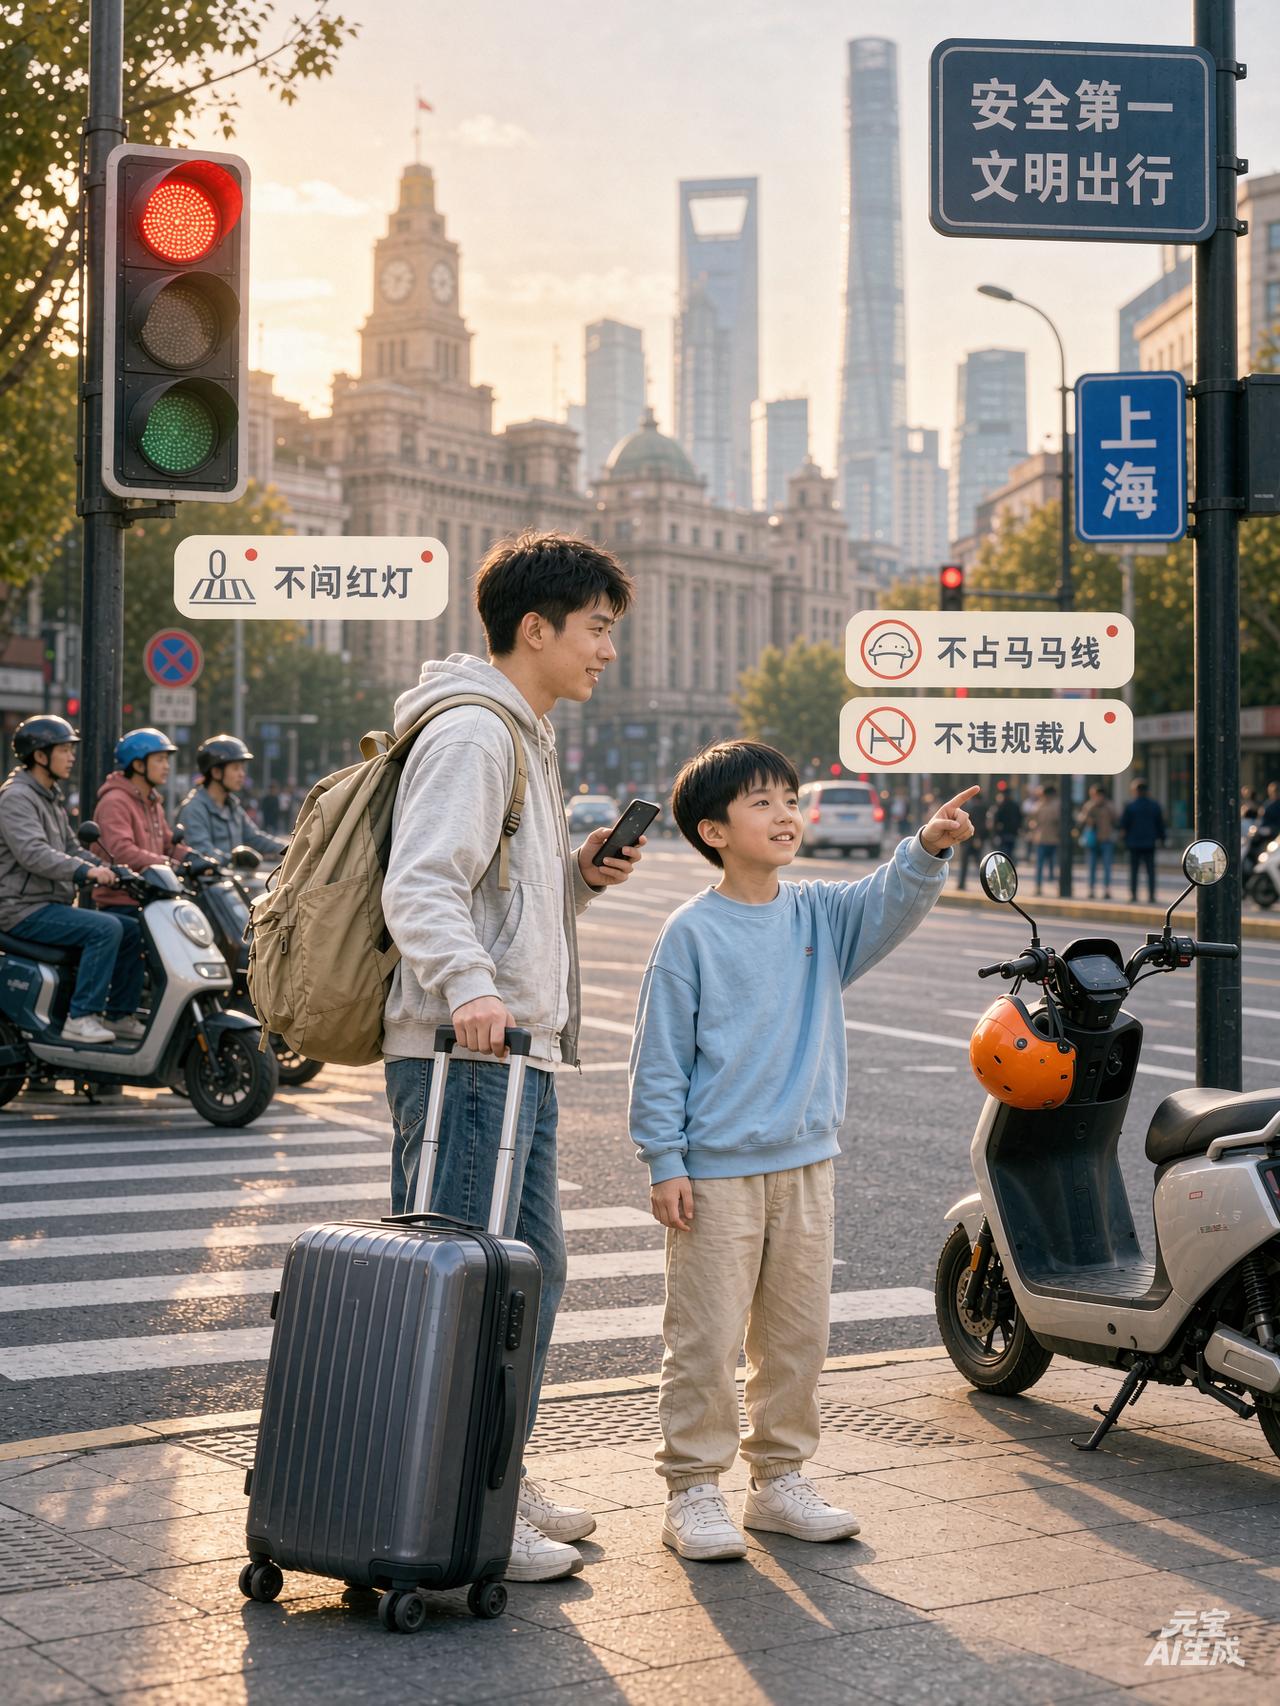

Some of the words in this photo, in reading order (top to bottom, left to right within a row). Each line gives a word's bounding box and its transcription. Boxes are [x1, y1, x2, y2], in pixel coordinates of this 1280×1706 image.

[971, 78, 1173, 133] 安全第一
[971, 150, 1173, 205] 文明出行
[1100, 395, 1158, 520] 上海
